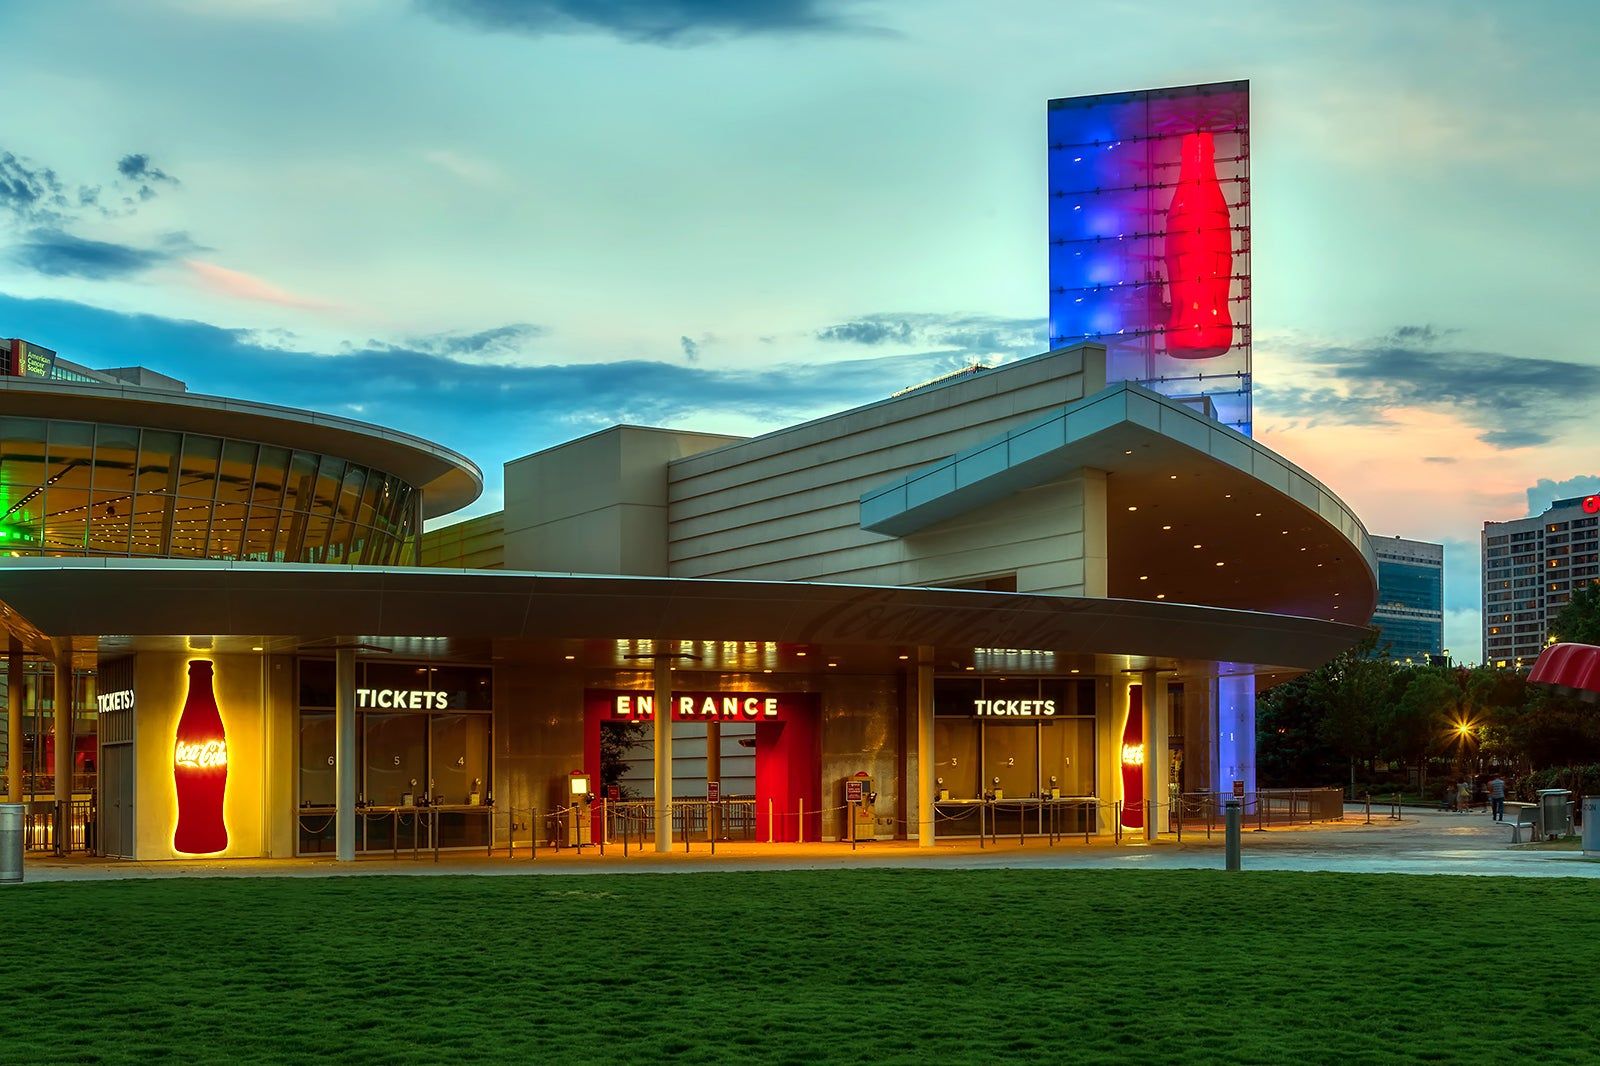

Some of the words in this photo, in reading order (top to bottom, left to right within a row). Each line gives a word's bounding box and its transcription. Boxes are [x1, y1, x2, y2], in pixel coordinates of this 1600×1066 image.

[28, 351, 51, 364] American
[28, 358, 45, 369] Cancer
[28, 365, 46, 377] Society
[356, 688, 448, 709] TICKETS
[616, 695, 778, 716] ENRANCE
[974, 699, 1056, 716] TICKETS
[327, 756, 335, 766] 6
[393, 756, 401, 766] 5
[457, 756, 465, 766] 4
[951, 757, 958, 766] 3
[1008, 757, 1014, 766] 2
